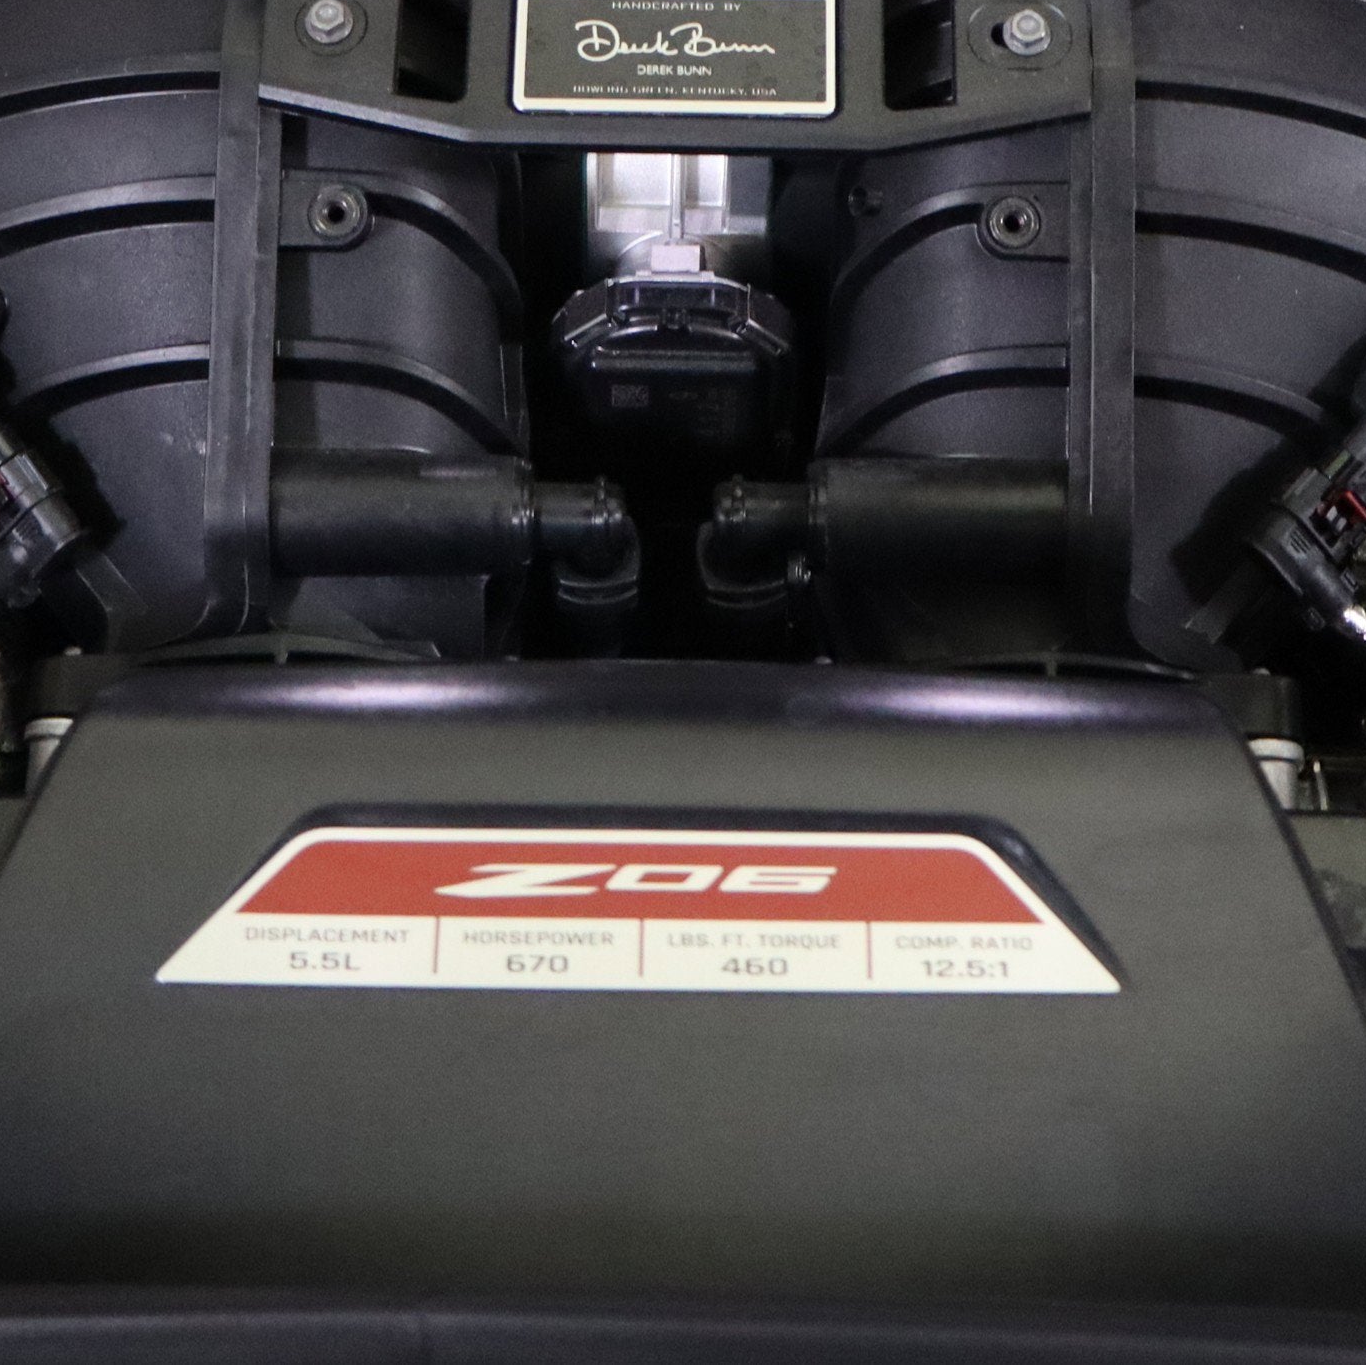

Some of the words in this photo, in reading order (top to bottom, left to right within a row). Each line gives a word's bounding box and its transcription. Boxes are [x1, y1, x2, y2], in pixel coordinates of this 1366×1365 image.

[612, 1, 714, 11] HANDCRAFTED
[724, 3, 741, 12] BY
[670, 22, 775, 56] Bunn
[637, 64, 673, 75] DEREK
[677, 65, 712, 76] BUNN
[752, 87, 777, 96] USA
[434, 863, 837, 898] Z06
[245, 927, 409, 943] DISPLACEMENT
[464, 929, 614, 945] HORSEPOWER
[668, 933, 714, 947] LBS.
[722, 933, 750, 947] FT.
[758, 934, 841, 949] TORQUE
[895, 936, 964, 950] COMP.
[971, 937, 1033, 951] RATIO
[290, 951, 361, 970] 5.5L
[506, 954, 569, 973] 670
[722, 958, 788, 976] 460
[921, 960, 1009, 978] 12.5:1
